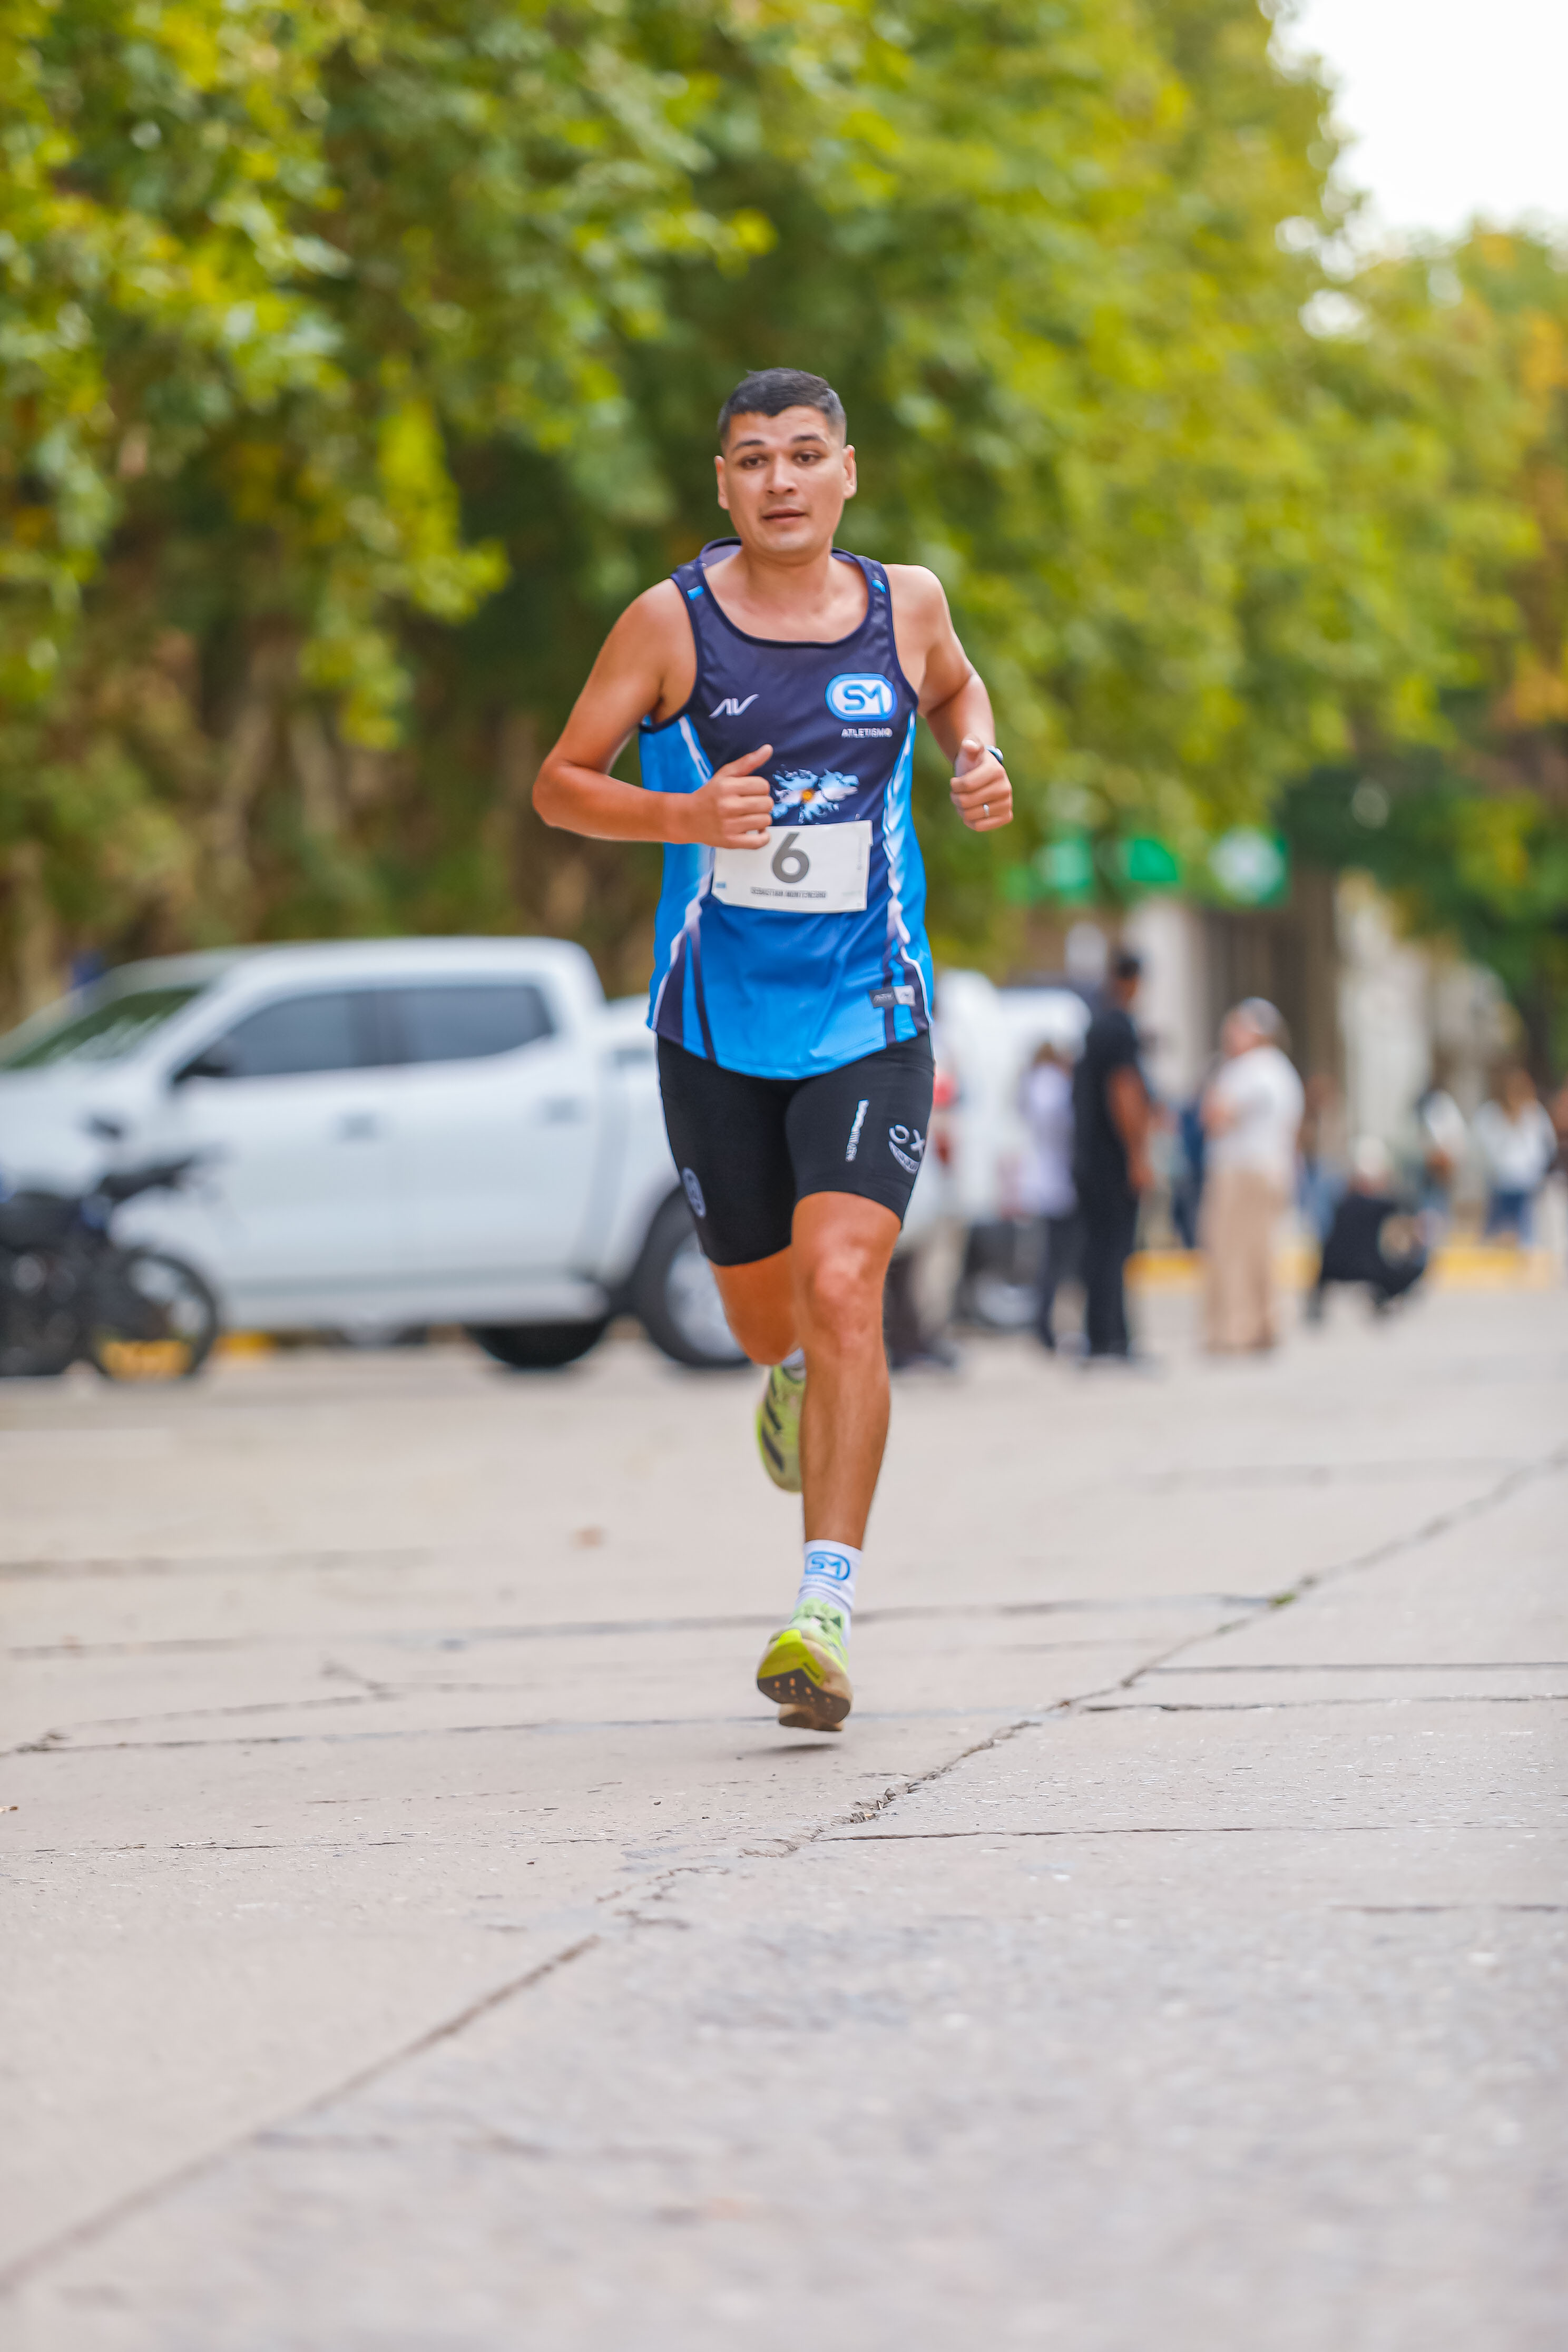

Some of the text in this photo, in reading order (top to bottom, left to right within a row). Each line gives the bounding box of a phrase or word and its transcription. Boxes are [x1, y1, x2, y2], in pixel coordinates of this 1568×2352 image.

[844, 684, 885, 718] SM
[841, 728, 893, 738] ATLETISMO
[772, 832, 810, 883] 6
